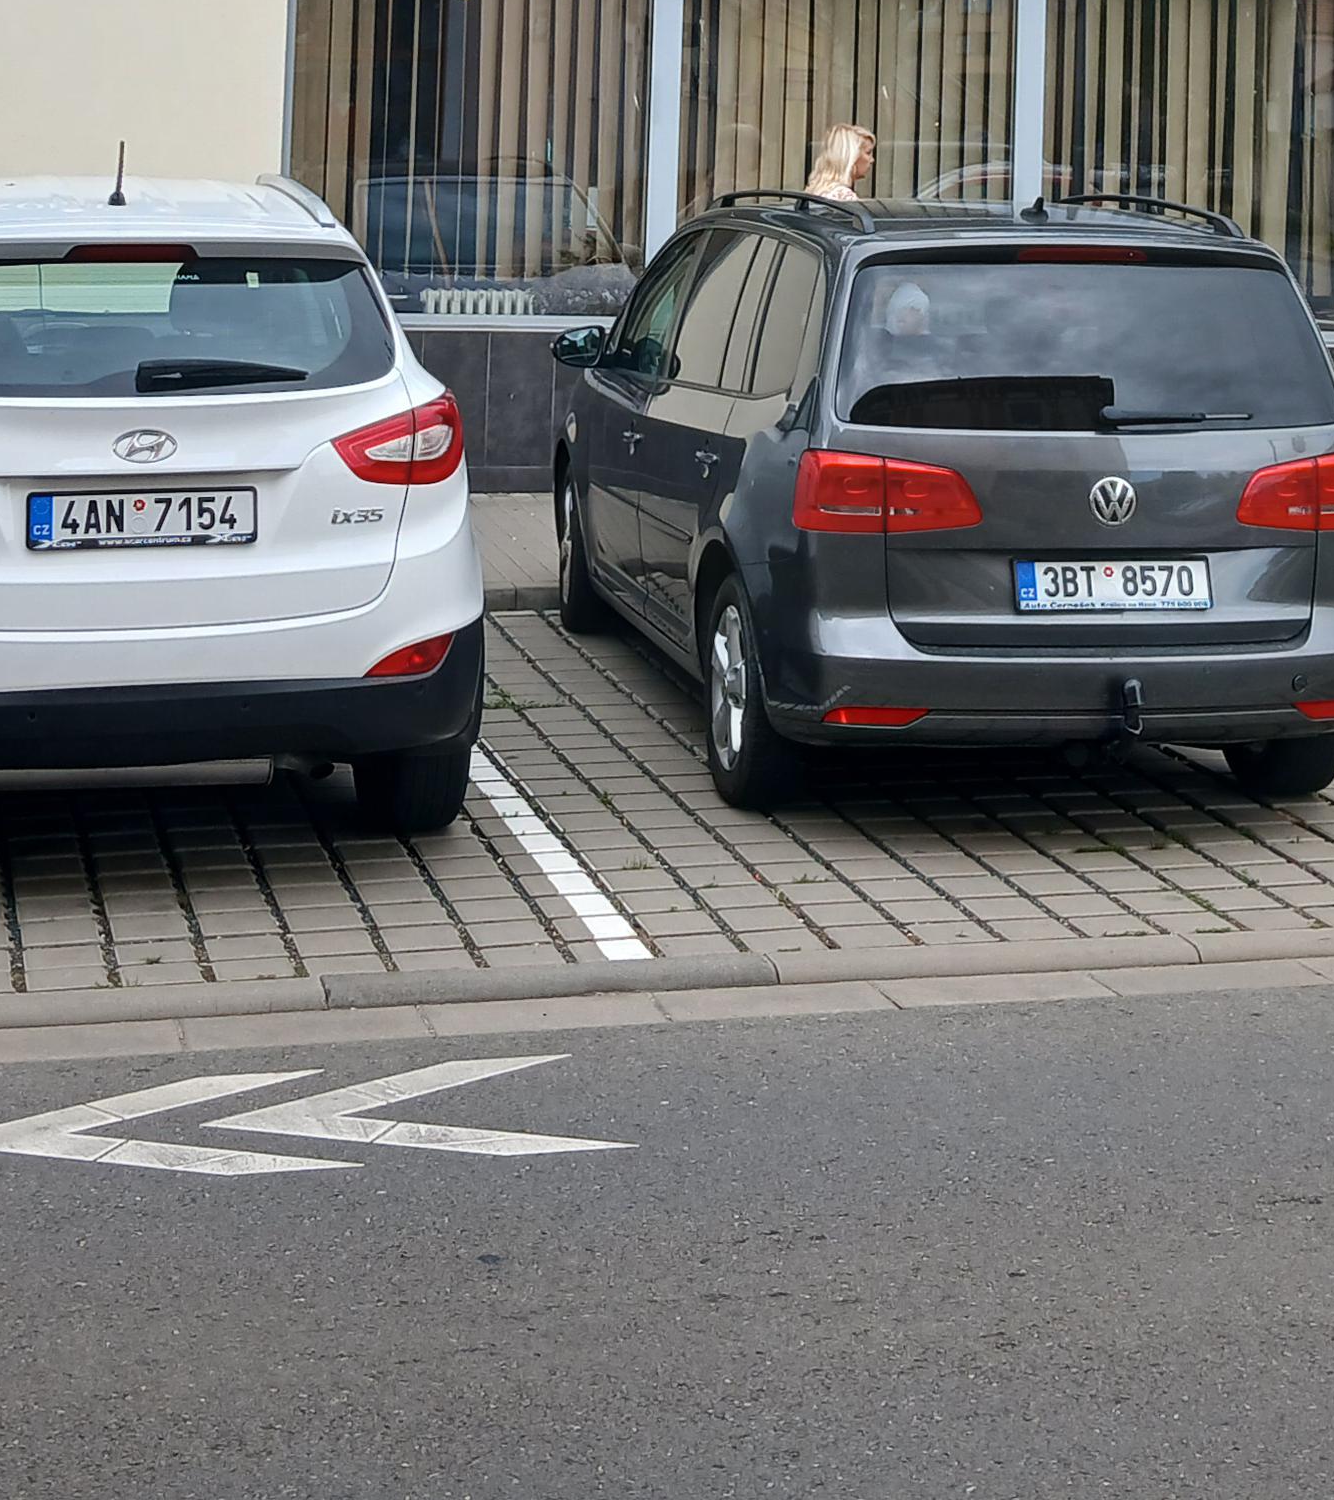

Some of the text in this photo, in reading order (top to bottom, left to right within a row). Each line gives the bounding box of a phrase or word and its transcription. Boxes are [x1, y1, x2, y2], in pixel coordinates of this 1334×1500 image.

[61, 496, 237, 535] 4AN 7154
[33, 525, 50, 536] CZ
[1043, 565, 1194, 597] 3BT 8570
[1021, 588, 1035, 598] CZ
